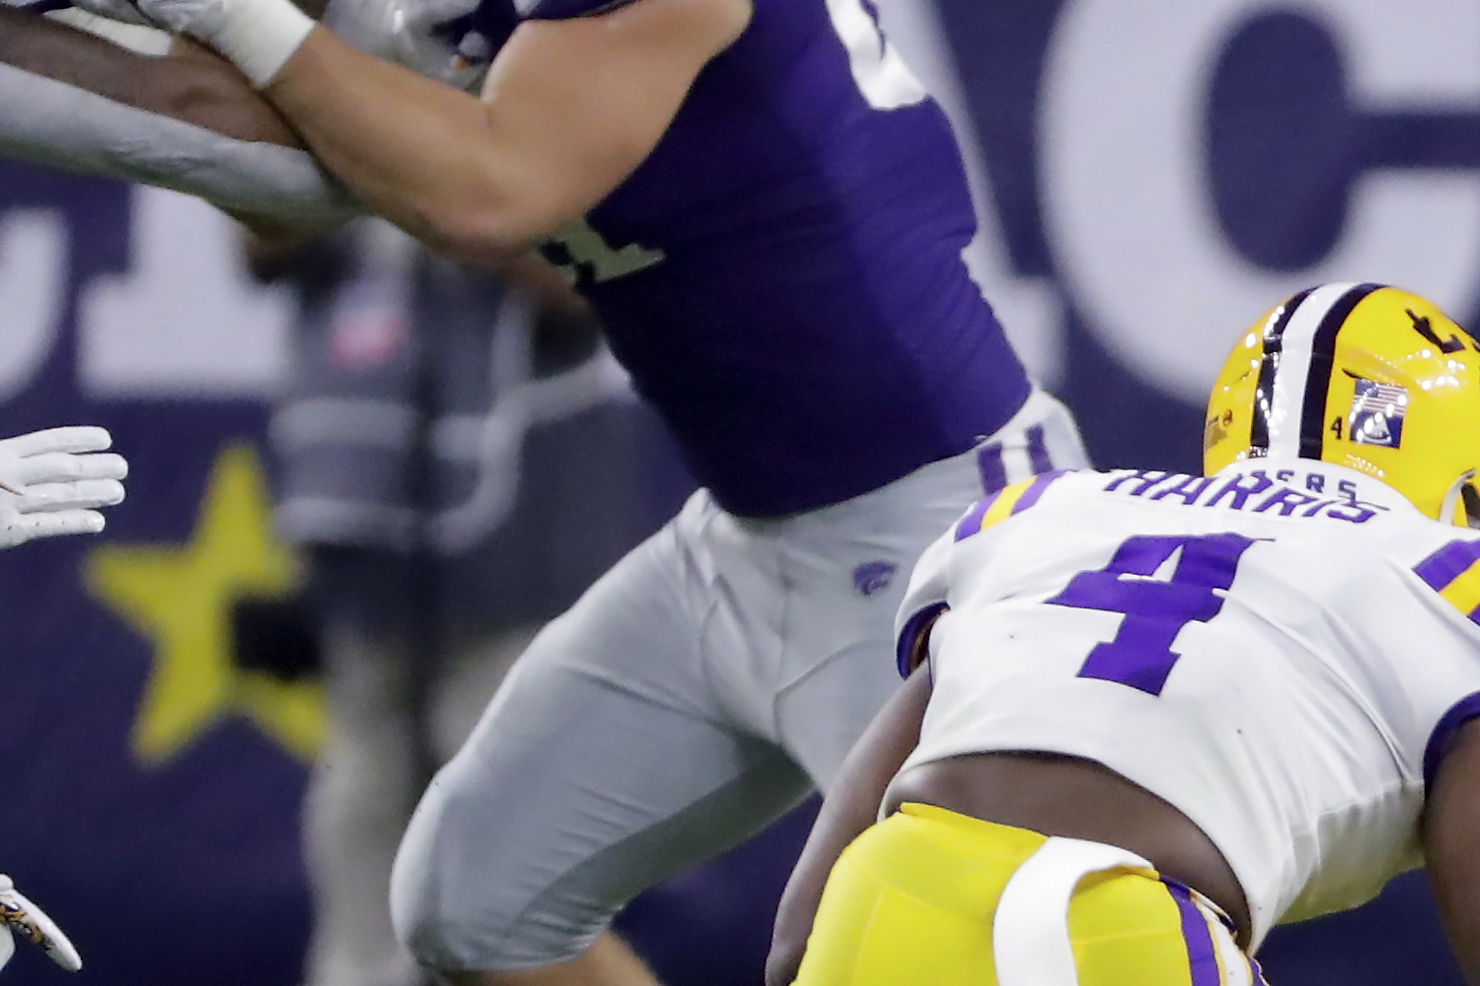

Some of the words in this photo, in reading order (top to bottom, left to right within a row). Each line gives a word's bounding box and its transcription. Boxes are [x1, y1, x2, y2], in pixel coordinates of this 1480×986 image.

[1330, 417, 1343, 440] 4
[1103, 469, 1390, 523] HARRIS
[1046, 532, 1276, 698] 4
